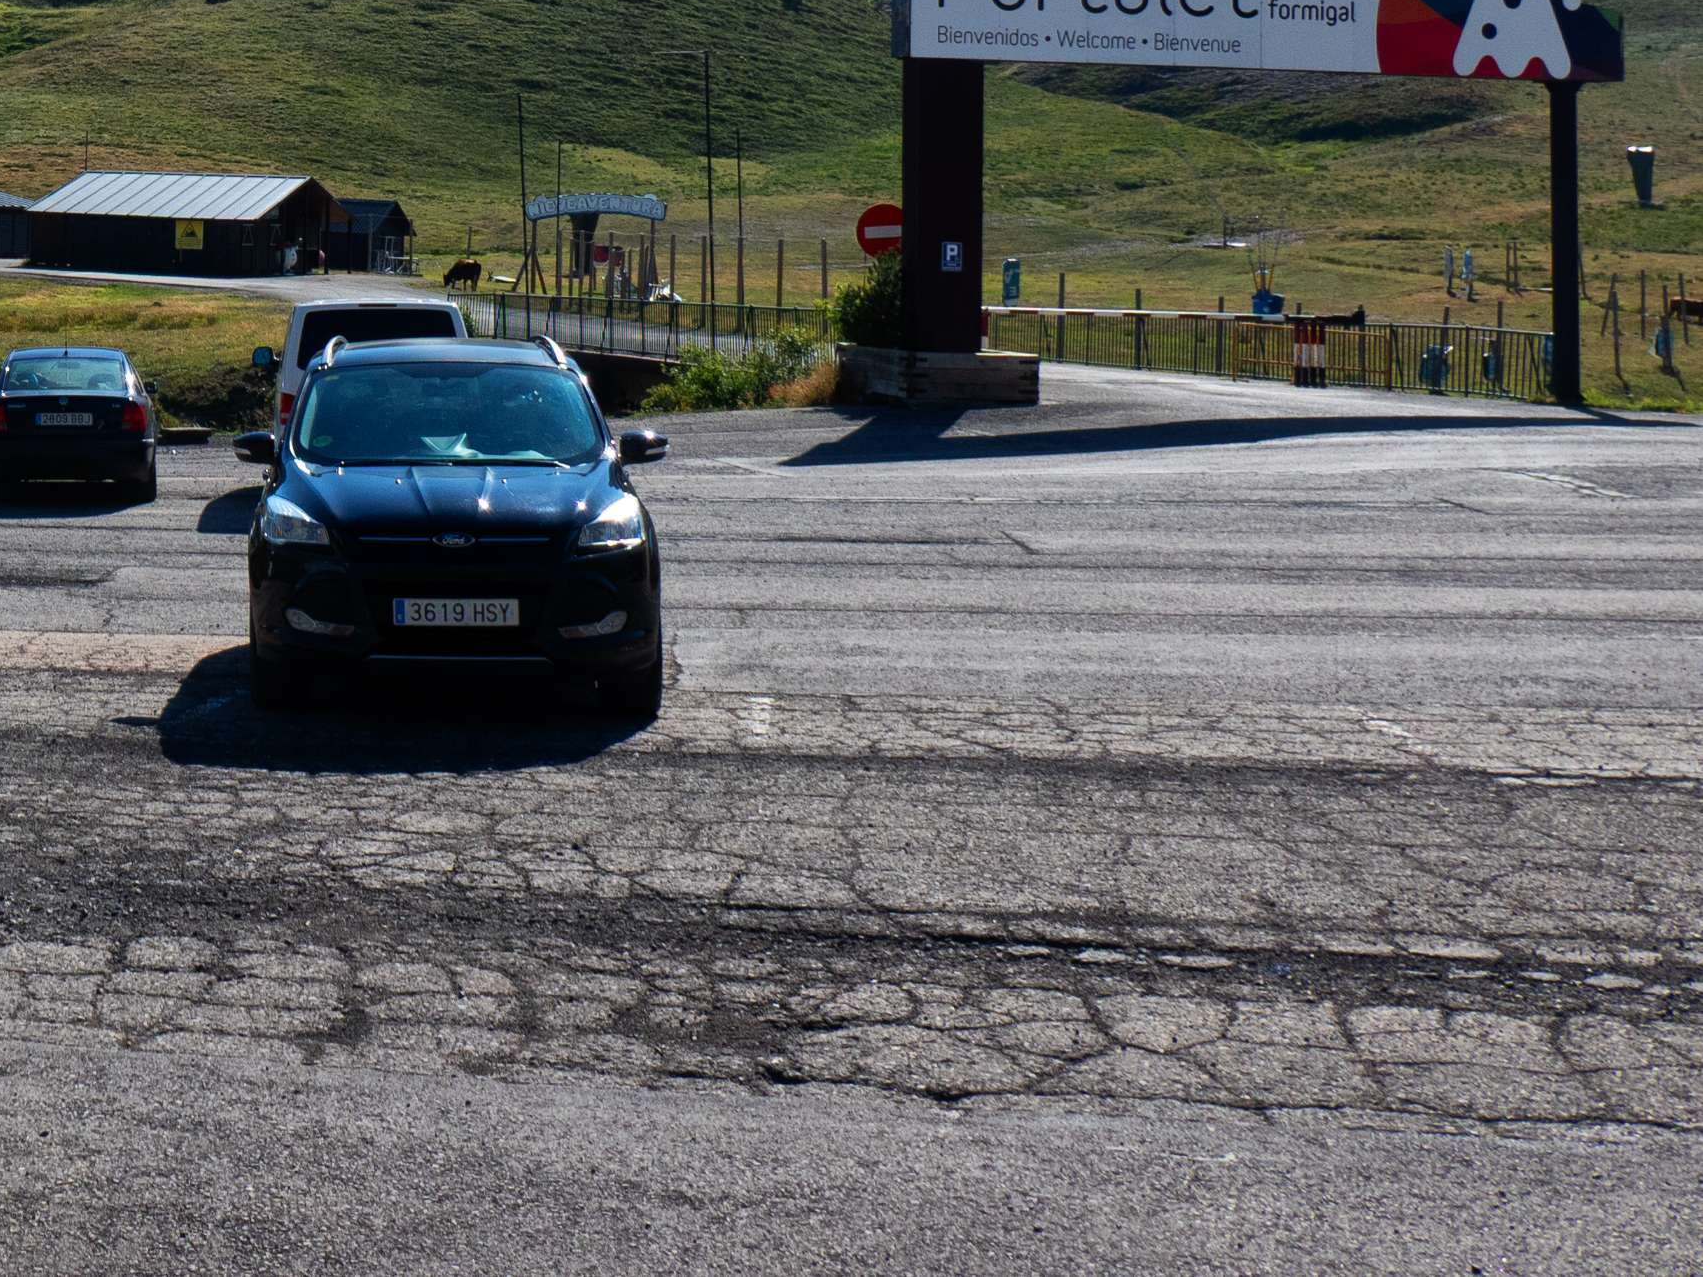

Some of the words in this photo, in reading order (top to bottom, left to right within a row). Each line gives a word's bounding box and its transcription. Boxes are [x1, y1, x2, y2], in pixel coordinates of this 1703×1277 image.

[937, 25, 1039, 47] Bienvenidos
[1056, 29, 1136, 50] Welcome
[1153, 32, 1242, 53] Bienvenue
[946, 244, 958, 261] P
[409, 602, 465, 623] 3619
[473, 602, 510, 623] HSY
